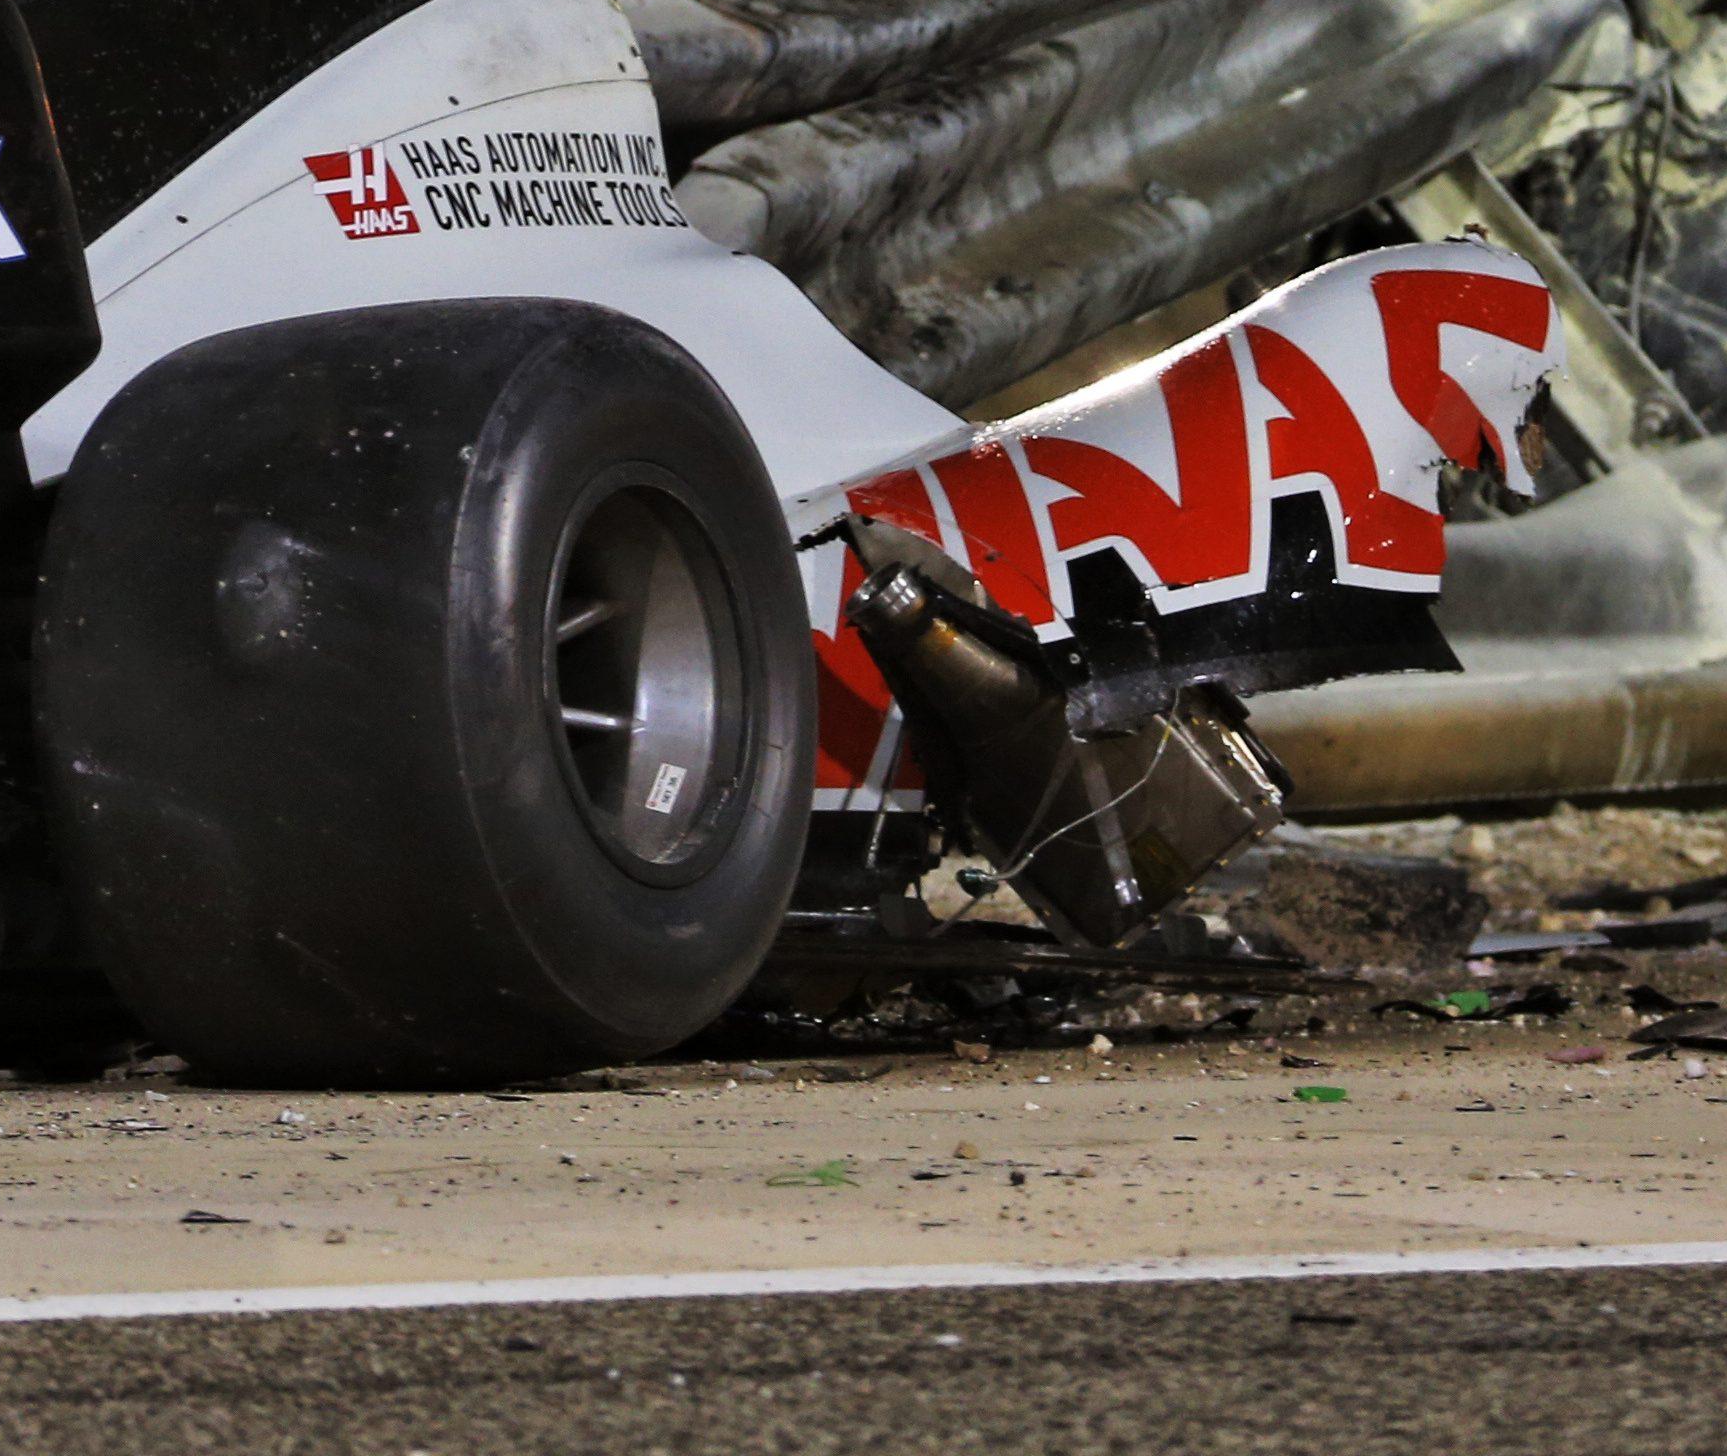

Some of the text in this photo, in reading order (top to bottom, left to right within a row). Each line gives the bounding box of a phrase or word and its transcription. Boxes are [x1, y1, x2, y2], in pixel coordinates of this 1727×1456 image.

[401, 132, 667, 179] HAAS AUTOMATION INC.
[341, 206, 414, 235] HAAS
[425, 180, 689, 231] CNC MACHINE TOOLS
